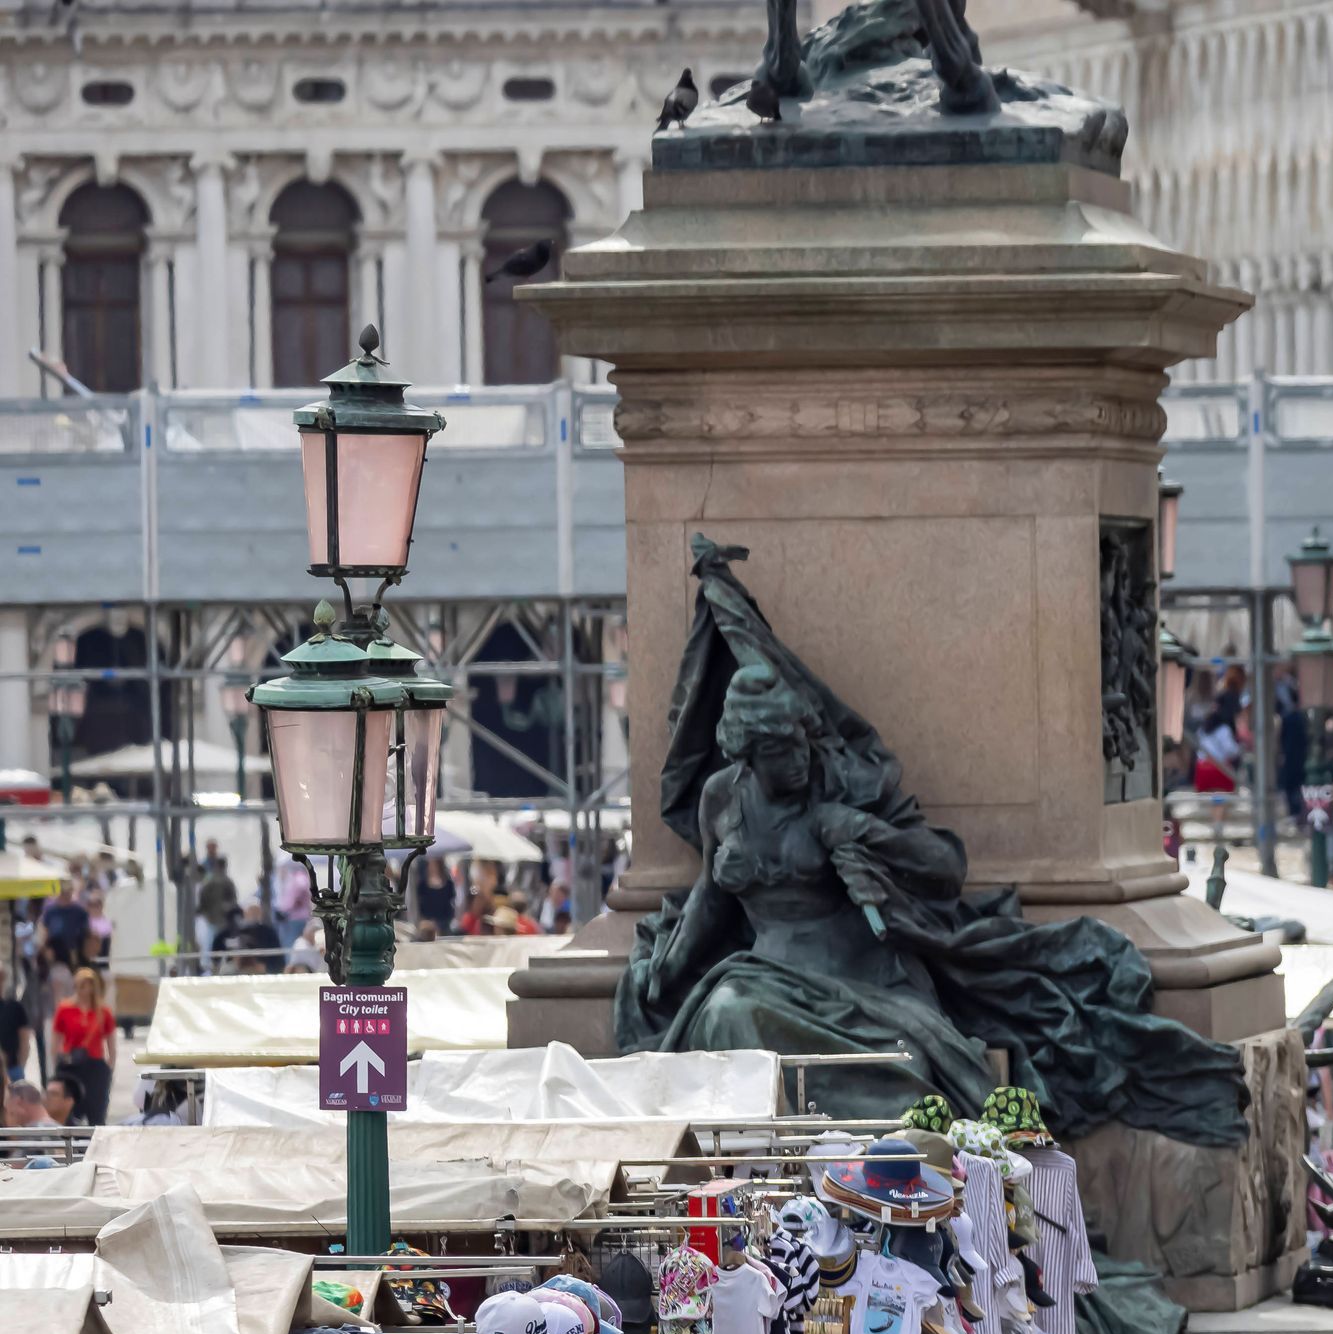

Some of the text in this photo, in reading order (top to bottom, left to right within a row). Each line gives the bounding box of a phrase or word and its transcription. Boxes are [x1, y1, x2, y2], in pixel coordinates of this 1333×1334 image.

[1301, 784, 1333, 800] WC
[323, 991, 404, 1004] Bagni comunali
[339, 1004, 389, 1016] City toilet
